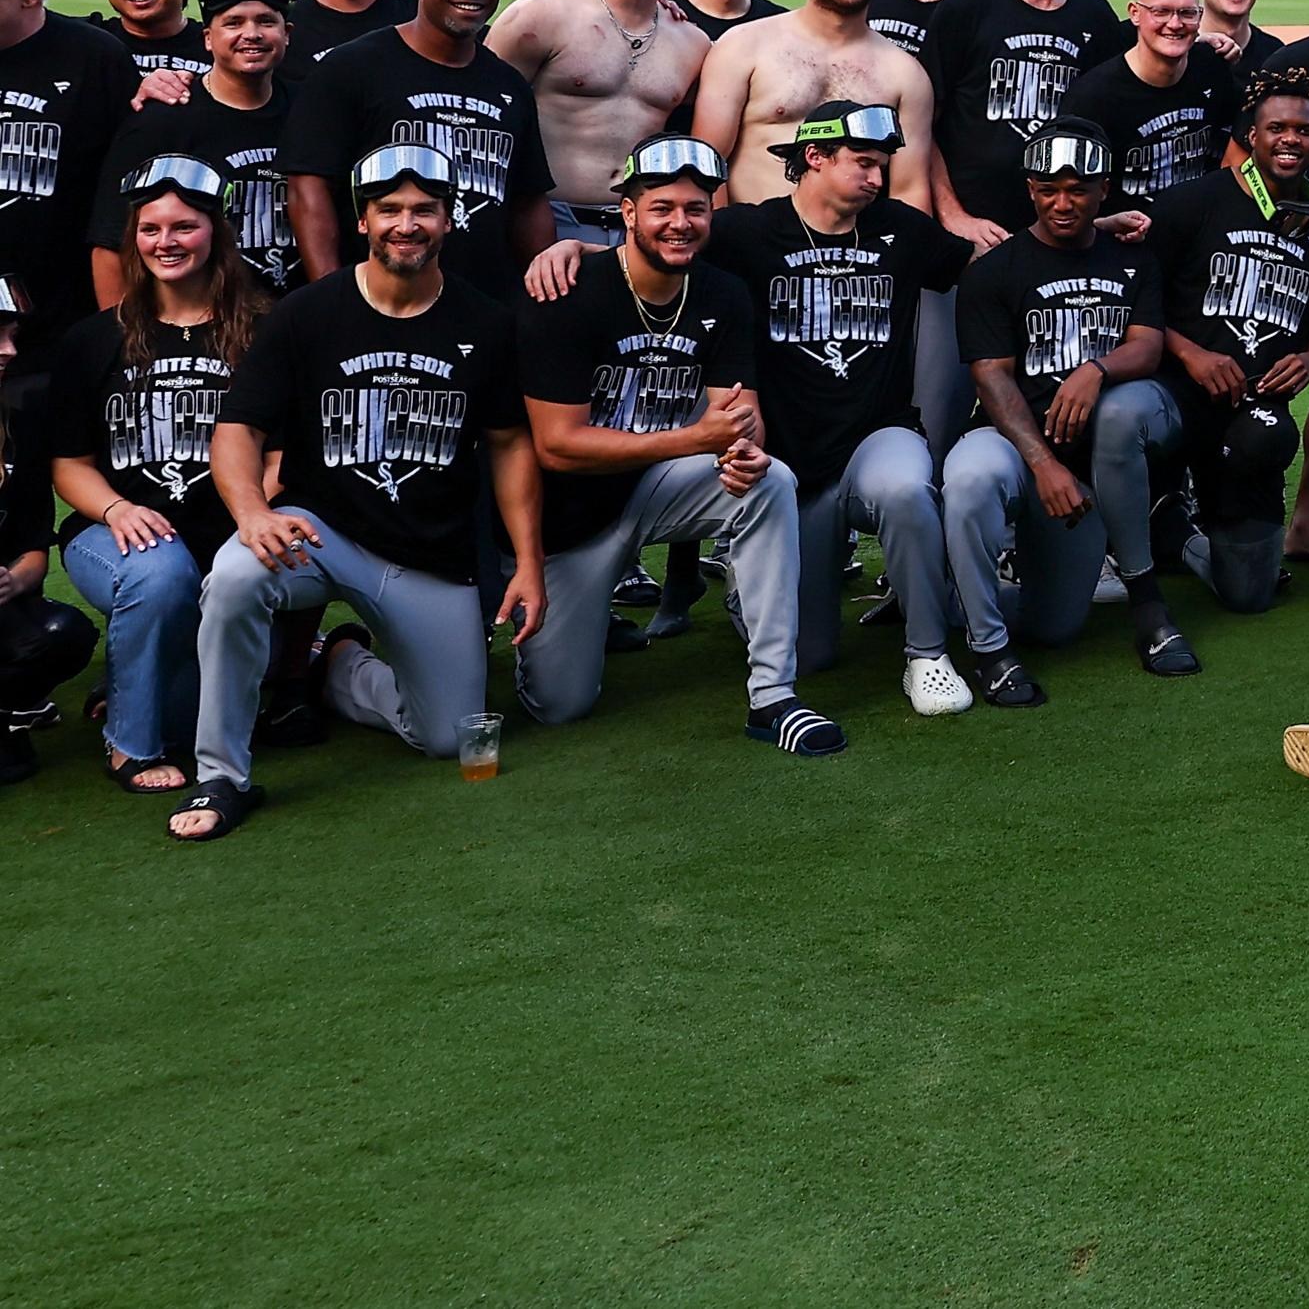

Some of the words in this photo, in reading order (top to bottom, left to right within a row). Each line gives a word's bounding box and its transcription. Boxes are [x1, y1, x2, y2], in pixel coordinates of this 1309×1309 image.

[785, 249, 839, 266] WHITE
[842, 247, 880, 266] SOX
[1036, 279, 1089, 299] WHITE
[1091, 278, 1124, 298] SOX
[769, 275, 894, 343] CLINCHED
[340, 352, 406, 377] WHITE
[408, 353, 452, 379] SOX
[321, 388, 466, 468] CLINCHED
